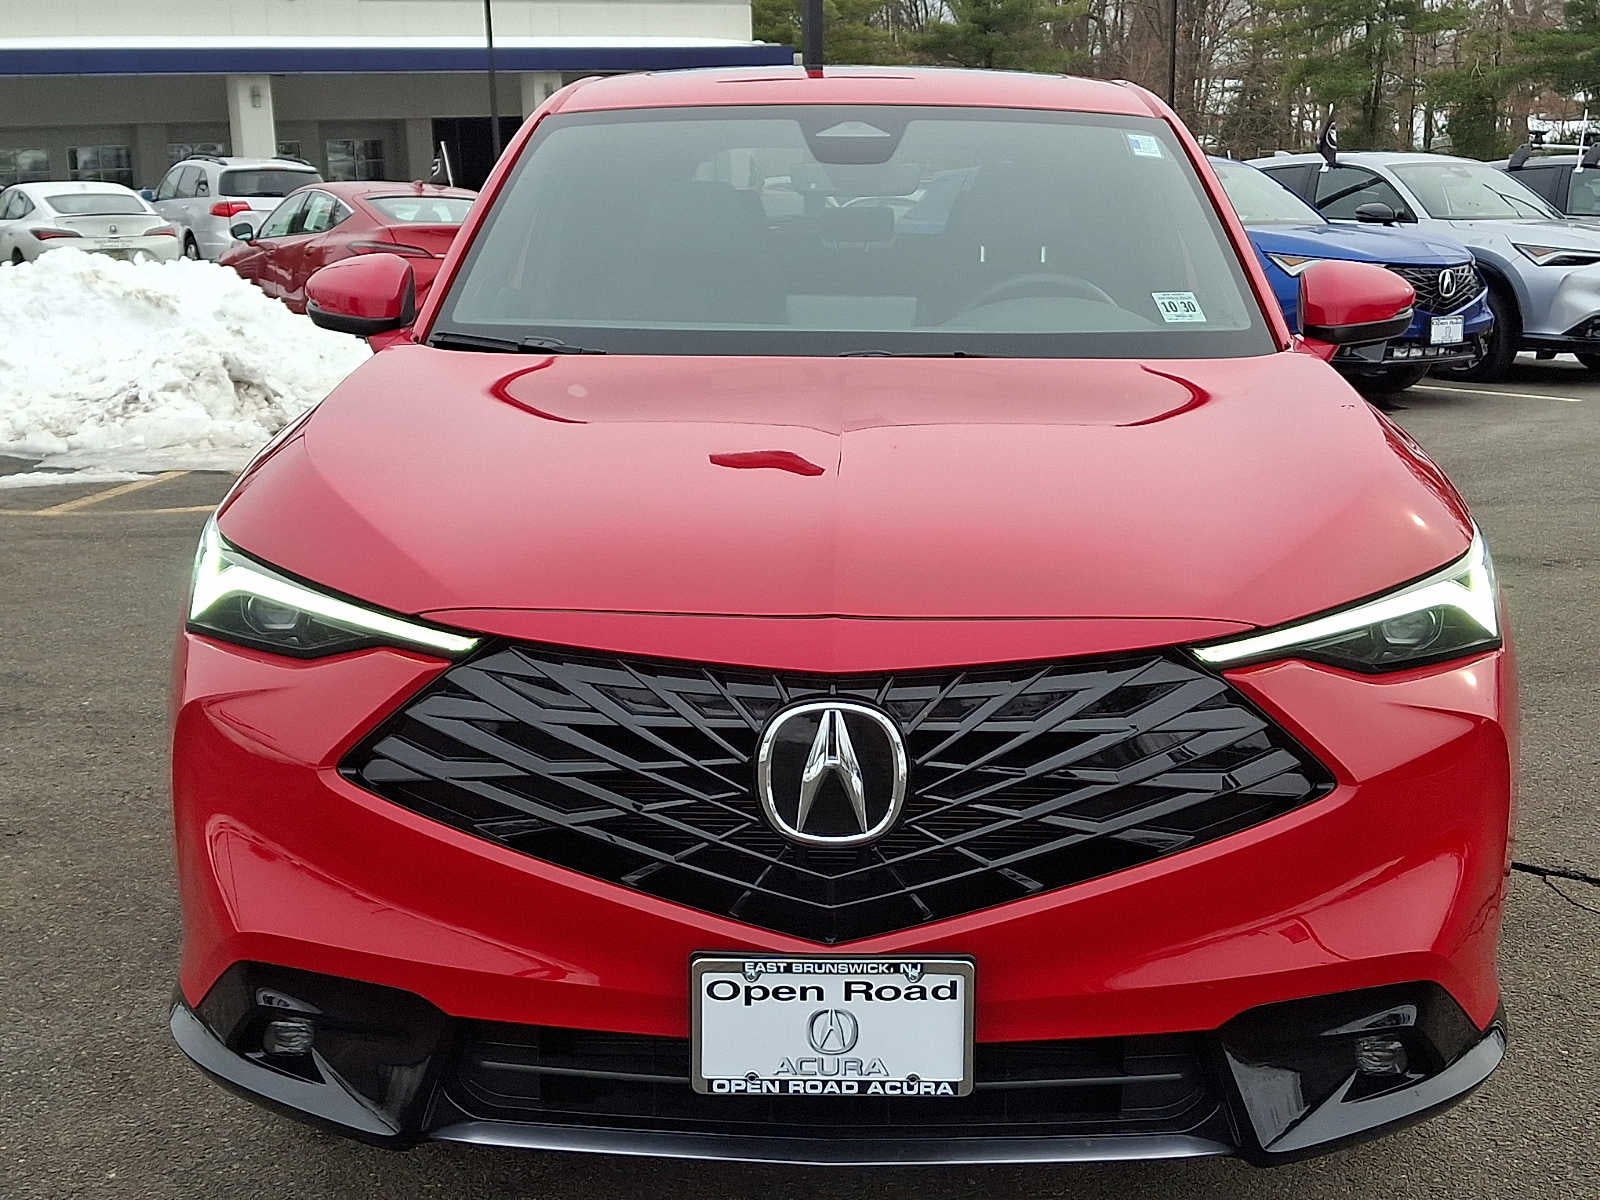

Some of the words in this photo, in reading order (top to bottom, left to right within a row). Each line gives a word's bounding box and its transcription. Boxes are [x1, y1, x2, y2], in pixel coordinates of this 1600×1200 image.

[1161, 301, 1178, 313] 10
[1180, 301, 1196, 313] 30
[744, 962, 787, 973] EAST
[899, 963, 921, 975] NJ
[705, 979, 825, 1005] Open
[844, 979, 958, 1002] Road
[772, 1057, 890, 1077] ACURA
[712, 1080, 780, 1094] OPEN
[788, 1081, 858, 1095] ROAD
[867, 1081, 954, 1096] ACURA
